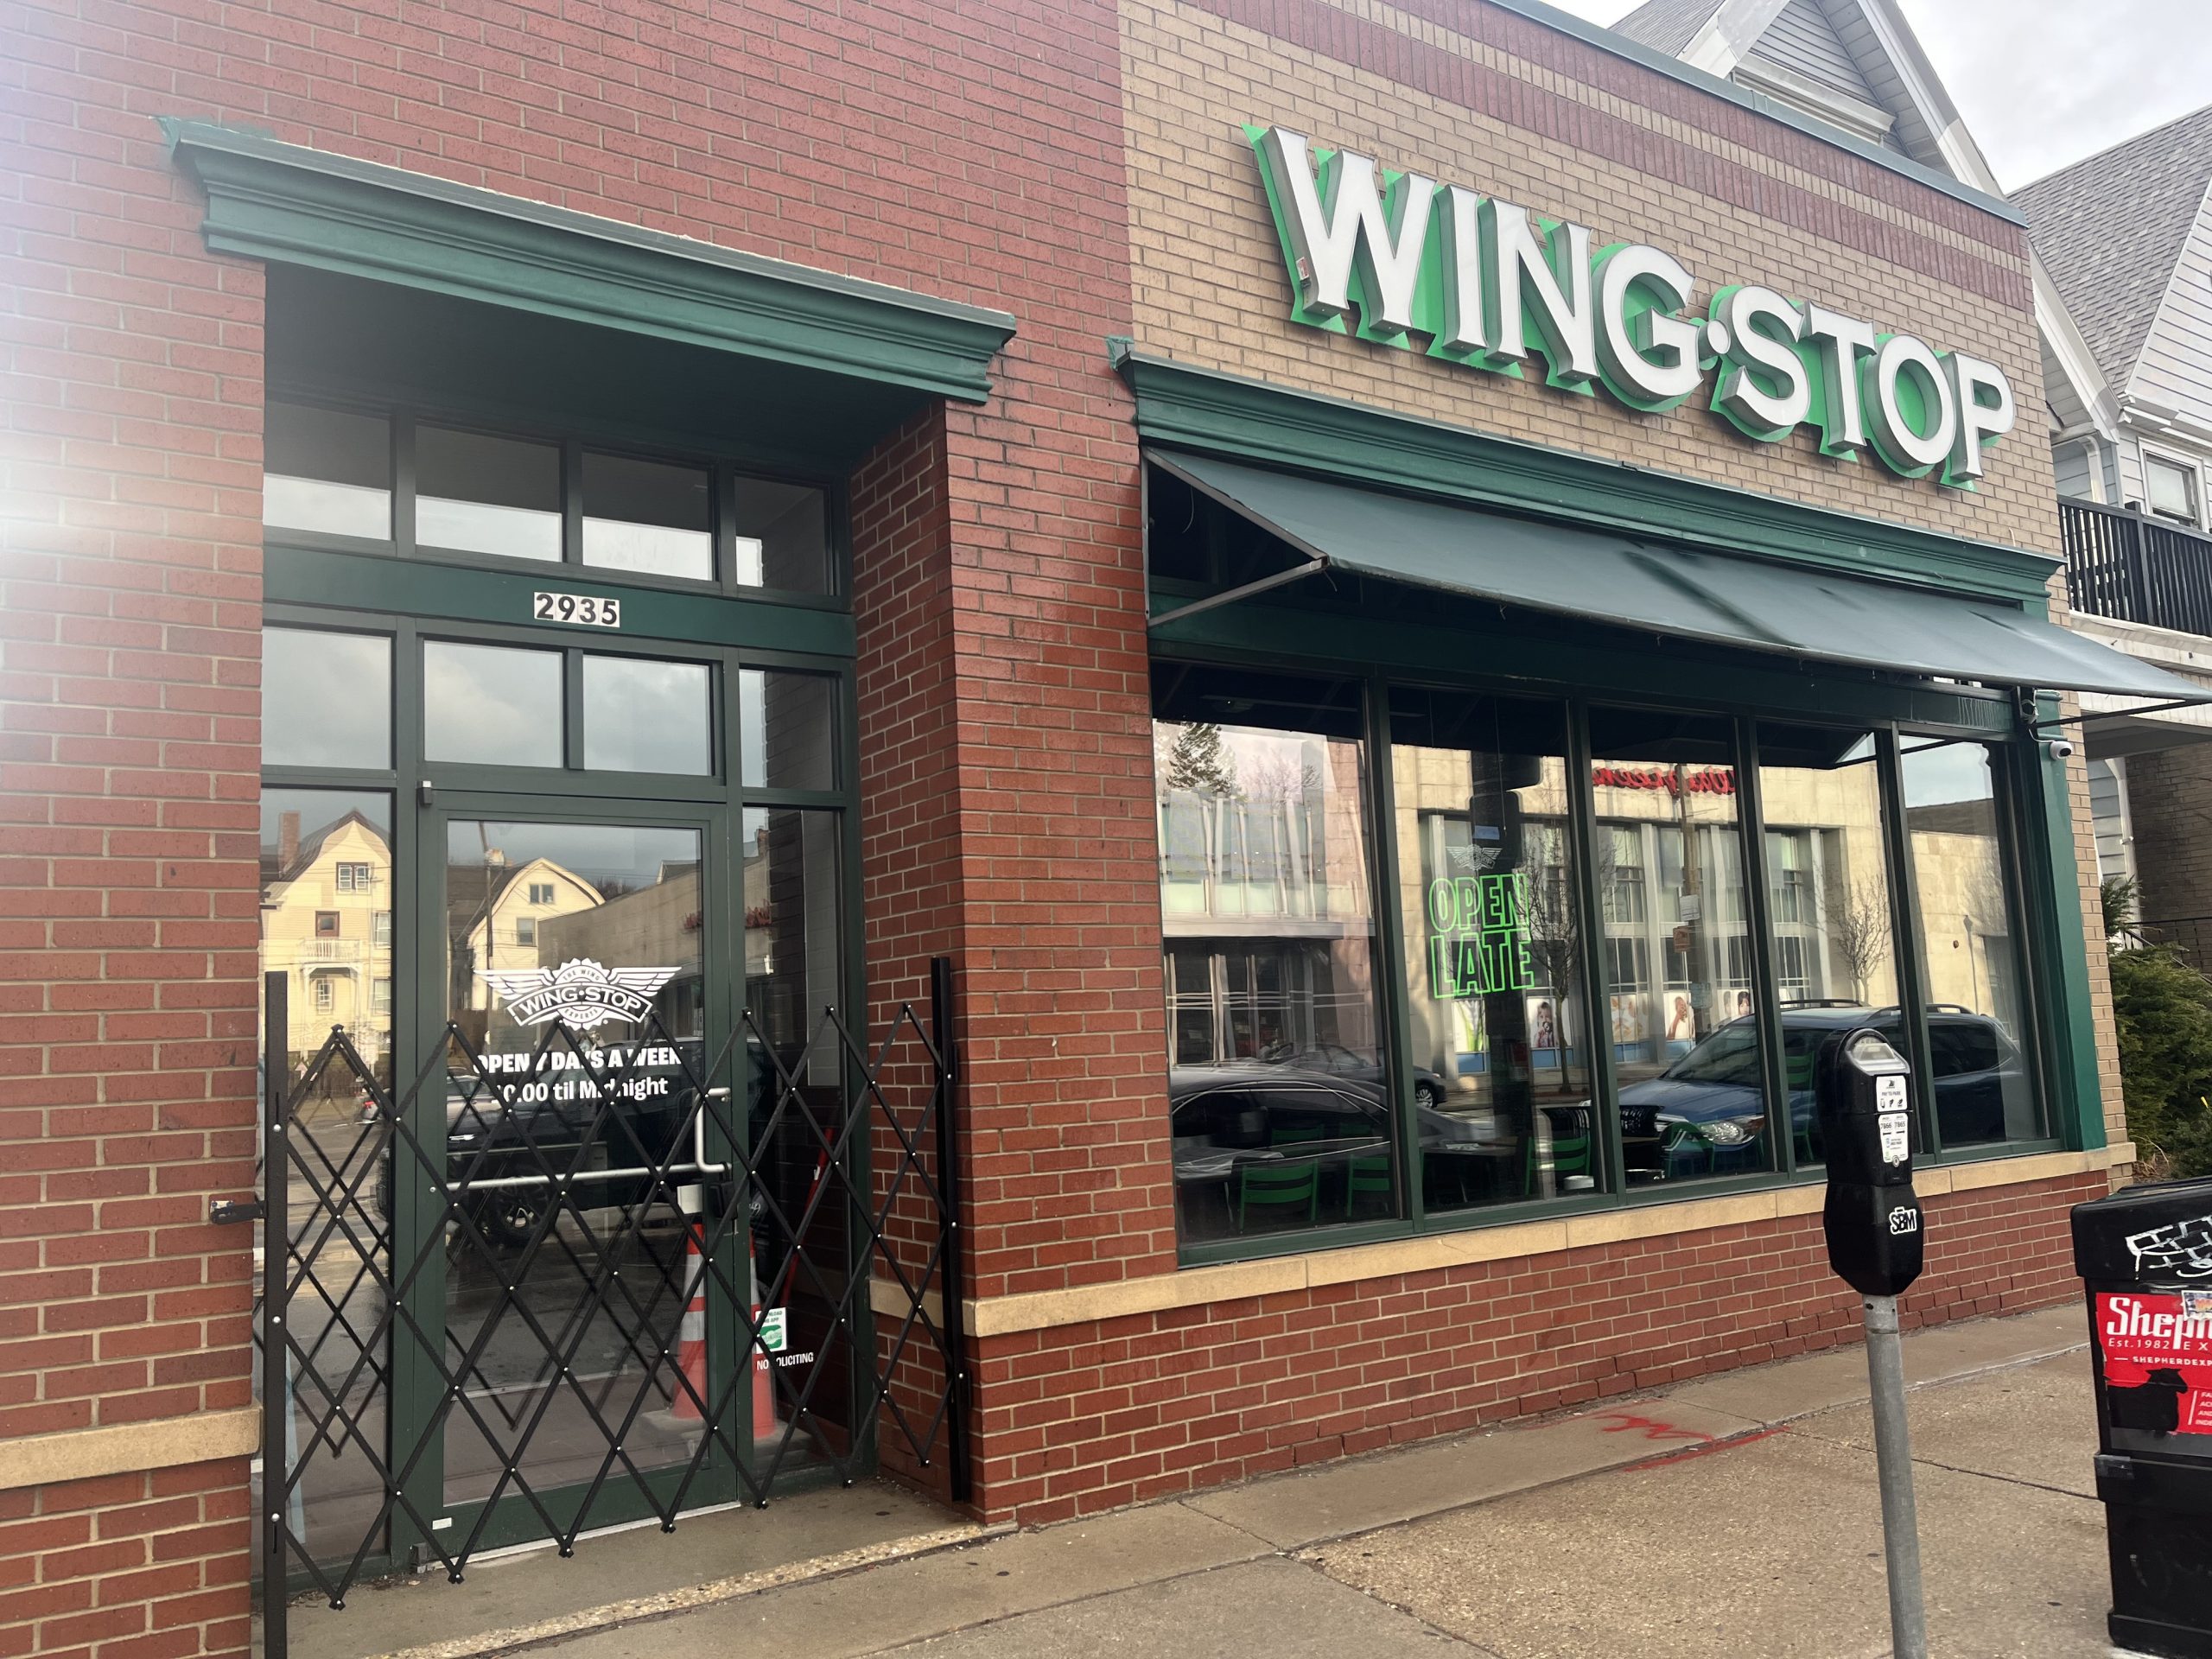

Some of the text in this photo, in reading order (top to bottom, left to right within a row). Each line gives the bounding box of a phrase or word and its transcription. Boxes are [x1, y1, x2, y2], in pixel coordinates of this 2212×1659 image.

[536, 593, 618, 626] 2935
[1428, 873, 1531, 932] OPEN
[1430, 927, 1535, 999] LATE
[563, 969, 601, 981] THE WING
[607, 1049, 624, 1068] A
[553, 1080, 575, 1100] til
[756, 1351, 814, 1370] NO OLICITING
